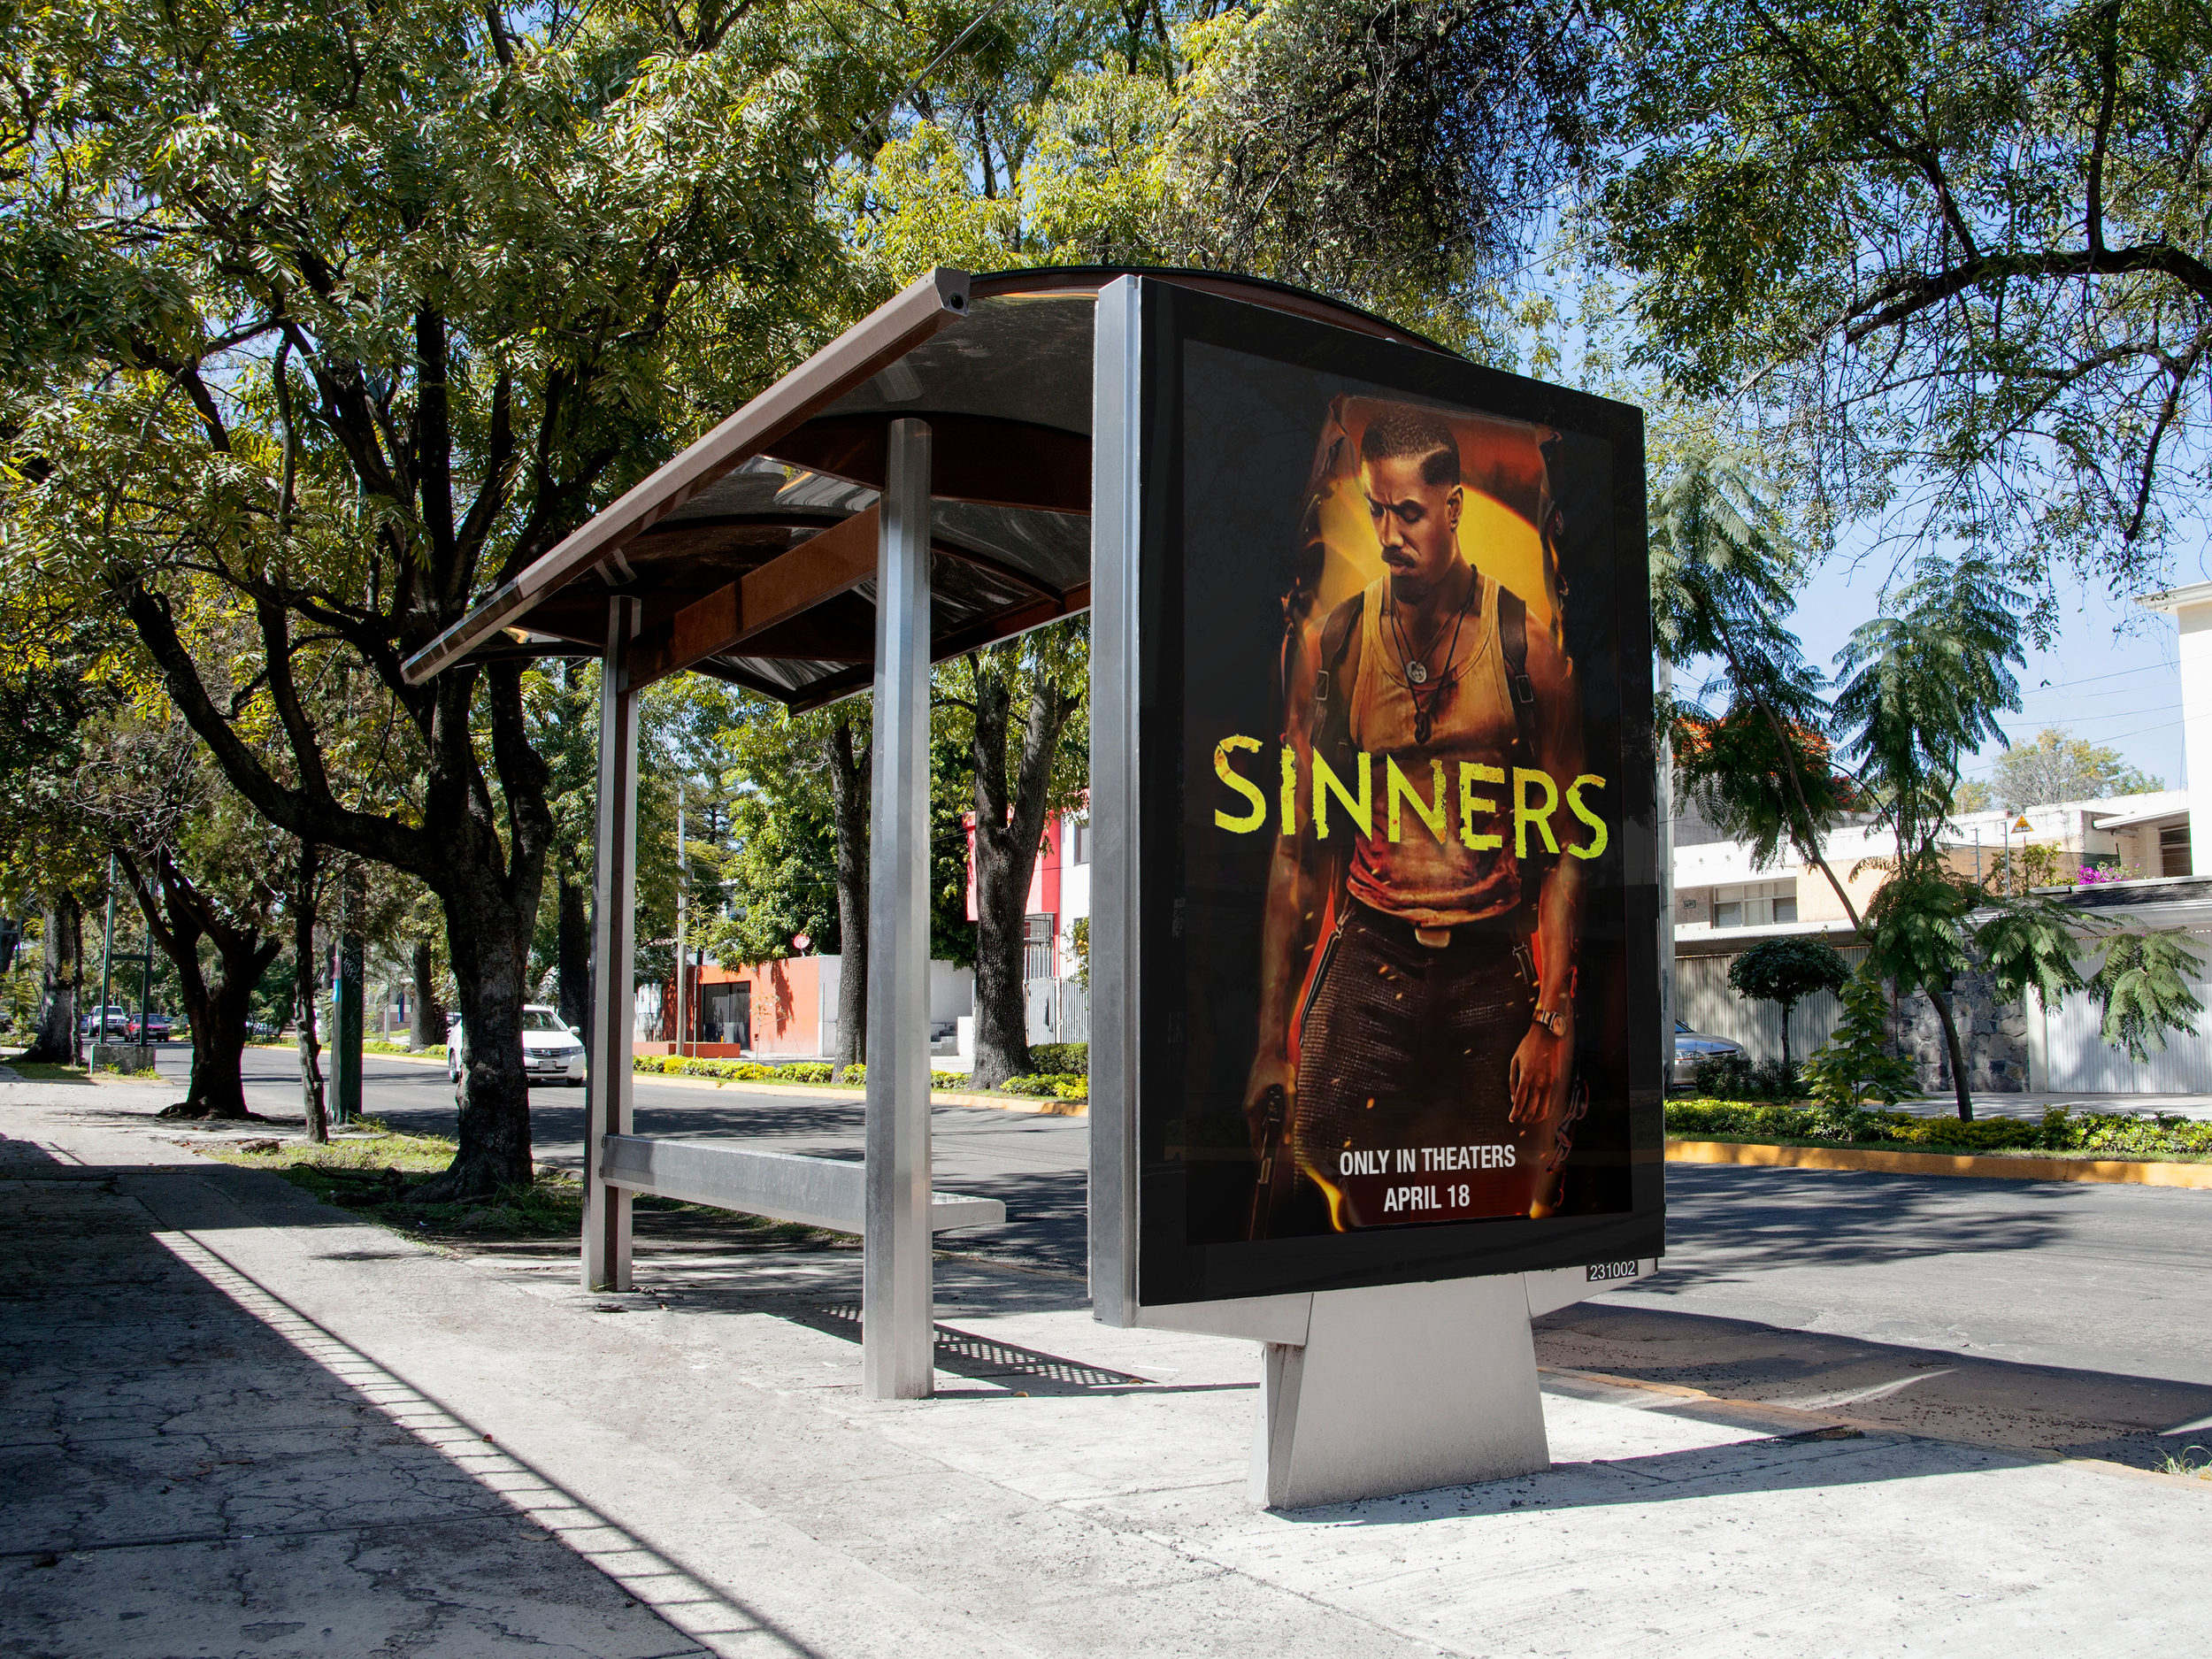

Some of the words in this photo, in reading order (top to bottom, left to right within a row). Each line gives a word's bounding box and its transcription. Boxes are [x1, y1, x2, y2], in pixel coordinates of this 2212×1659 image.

[1214, 733, 1608, 860] SINNERS
[1340, 1149, 1390, 1176] ONLY
[1396, 1148, 1416, 1173] IN
[1421, 1144, 1516, 1171] THEATERS
[1384, 1185, 1442, 1212] APRIL
[1447, 1184, 1471, 1208] 18
[1590, 1260, 1636, 1280] 231002
